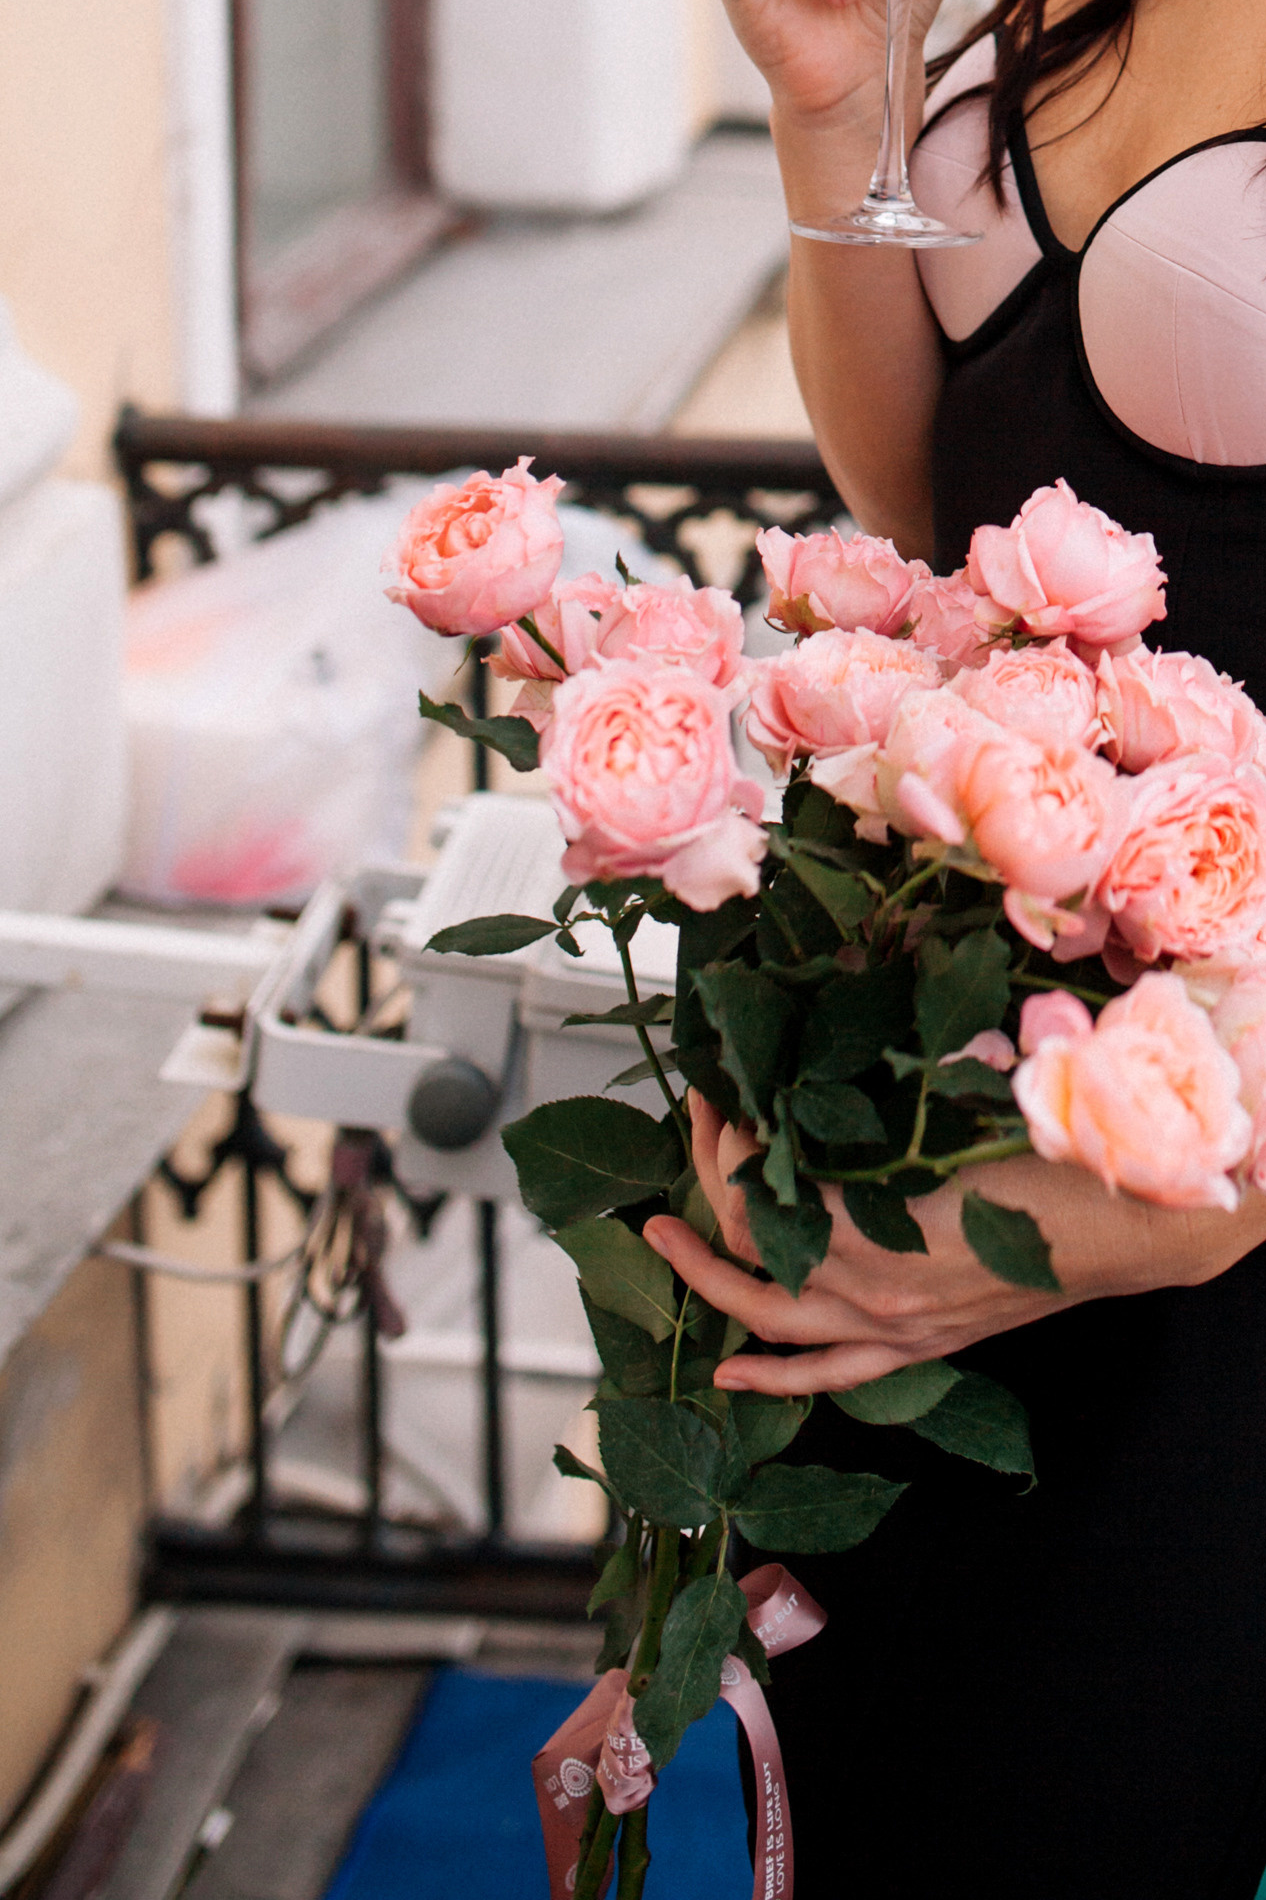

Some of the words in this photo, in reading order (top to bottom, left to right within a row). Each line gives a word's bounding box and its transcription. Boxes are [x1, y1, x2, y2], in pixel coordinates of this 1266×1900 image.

[774, 1593, 798, 1623] BUT
[630, 1738, 646, 1751] IS
[628, 1755, 642, 1768] IS
[763, 1762, 772, 1795] BUT
[766, 1797, 774, 1832] LIFE
[773, 1782, 782, 1830] LONG
[766, 1834, 774, 1852] IS
[775, 1832, 784, 1850] IS
[765, 1855, 774, 1900] BRIEF
[776, 1851, 784, 1894] LOVE
